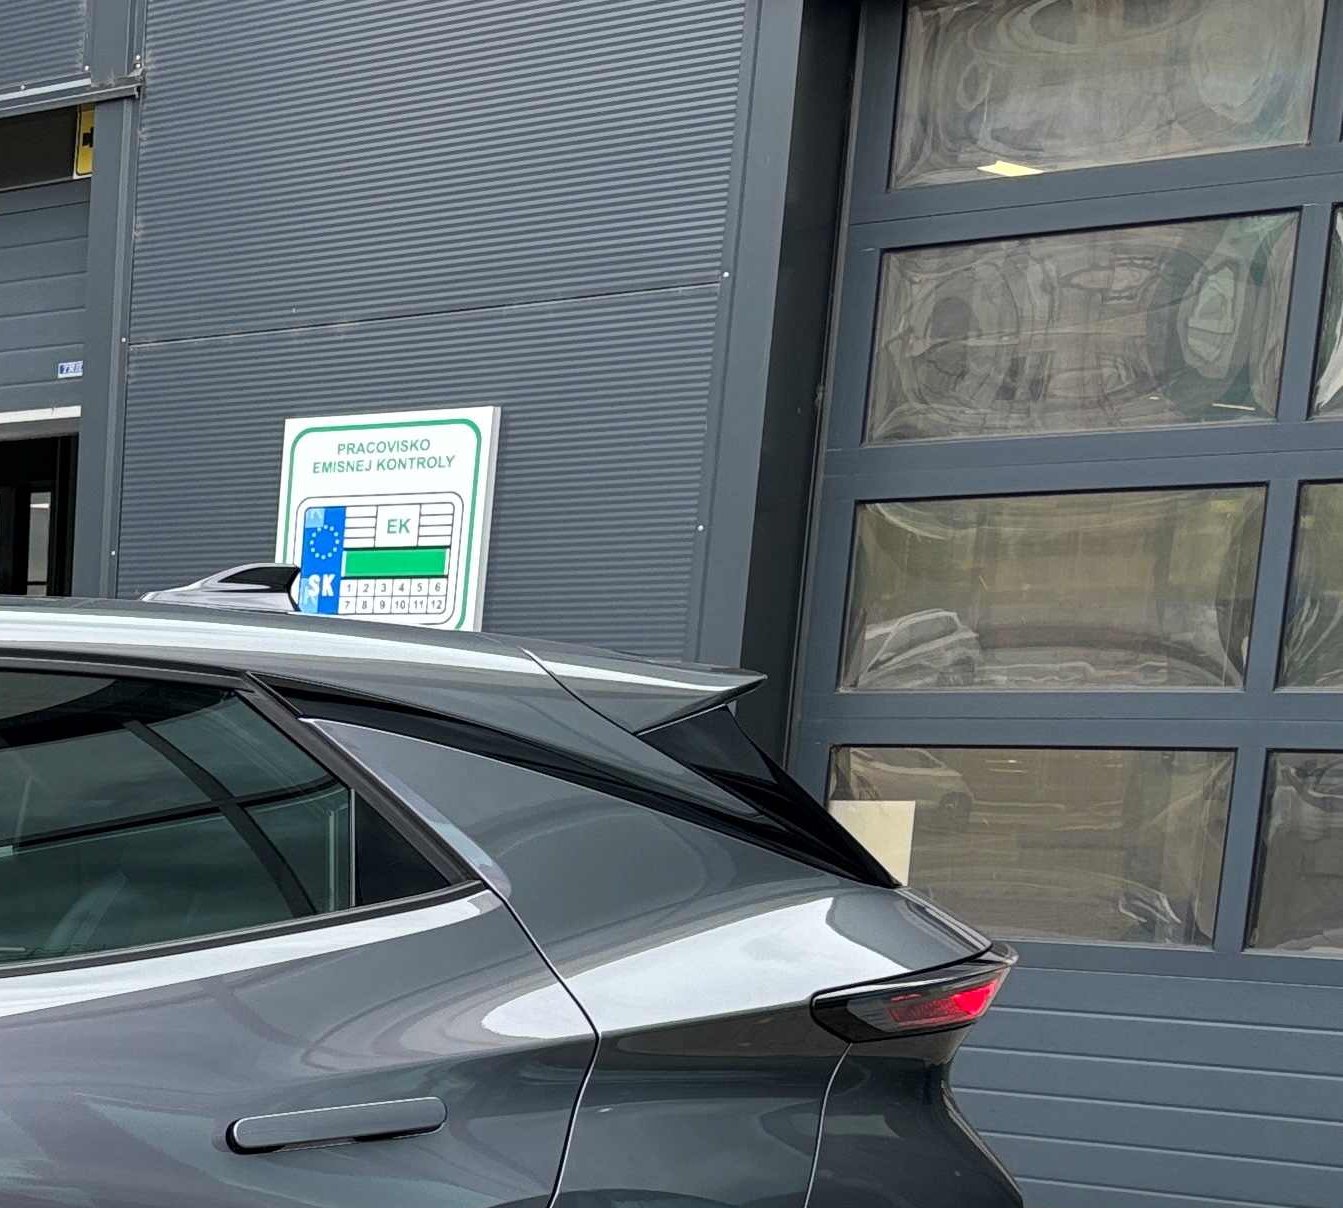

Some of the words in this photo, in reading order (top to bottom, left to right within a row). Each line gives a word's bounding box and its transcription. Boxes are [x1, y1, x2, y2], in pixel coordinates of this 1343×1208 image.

[337, 439, 431, 455] PRACOVISKO
[312, 460, 373, 474] EMISNEJ
[376, 455, 456, 472] KONTROLY
[386, 518, 411, 534] EK
[307, 574, 336, 597] SK
[347, 584, 351, 592] 1
[363, 584, 370, 593] 2
[381, 584, 387, 592] 3
[398, 584, 405, 592] 4
[417, 583, 423, 592] 5
[434, 583, 441, 592] 6
[344, 601, 351, 609] 7
[362, 601, 368, 609] 8
[379, 600, 386, 609] 9
[394, 600, 406, 610] 10
[414, 600, 424, 610] 11
[430, 600, 443, 609] 12
